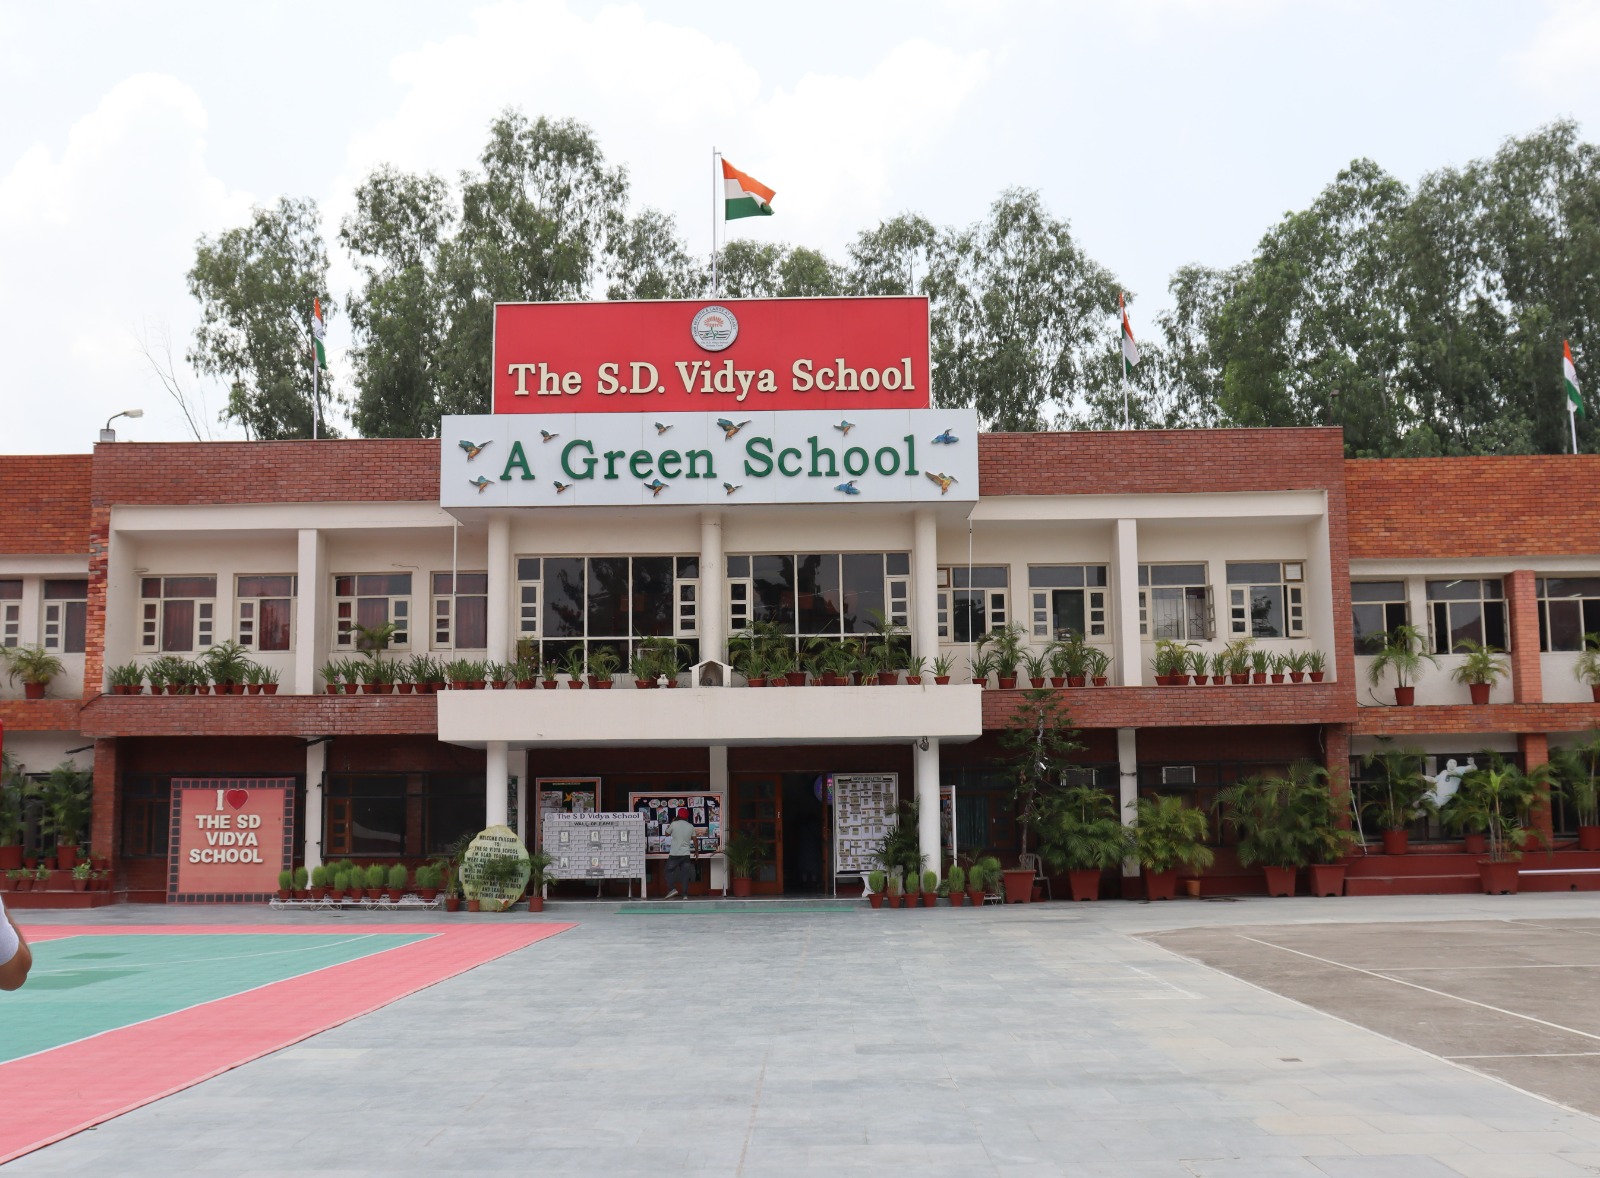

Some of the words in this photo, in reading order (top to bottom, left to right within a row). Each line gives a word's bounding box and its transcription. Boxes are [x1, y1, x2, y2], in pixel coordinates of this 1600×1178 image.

[509, 362, 582, 396] The
[597, 361, 666, 395] S.D.
[674, 359, 778, 402] Vidya
[792, 357, 915, 392] School
[500, 440, 536, 481] A
[561, 439, 718, 480] Green
[743, 434, 919, 477] School
[216, 789, 224, 811] I
[195, 814, 231, 829] THE
[236, 814, 261, 829] SD
[205, 831, 258, 846] VIDYA
[189, 848, 263, 863] SCHOOL
